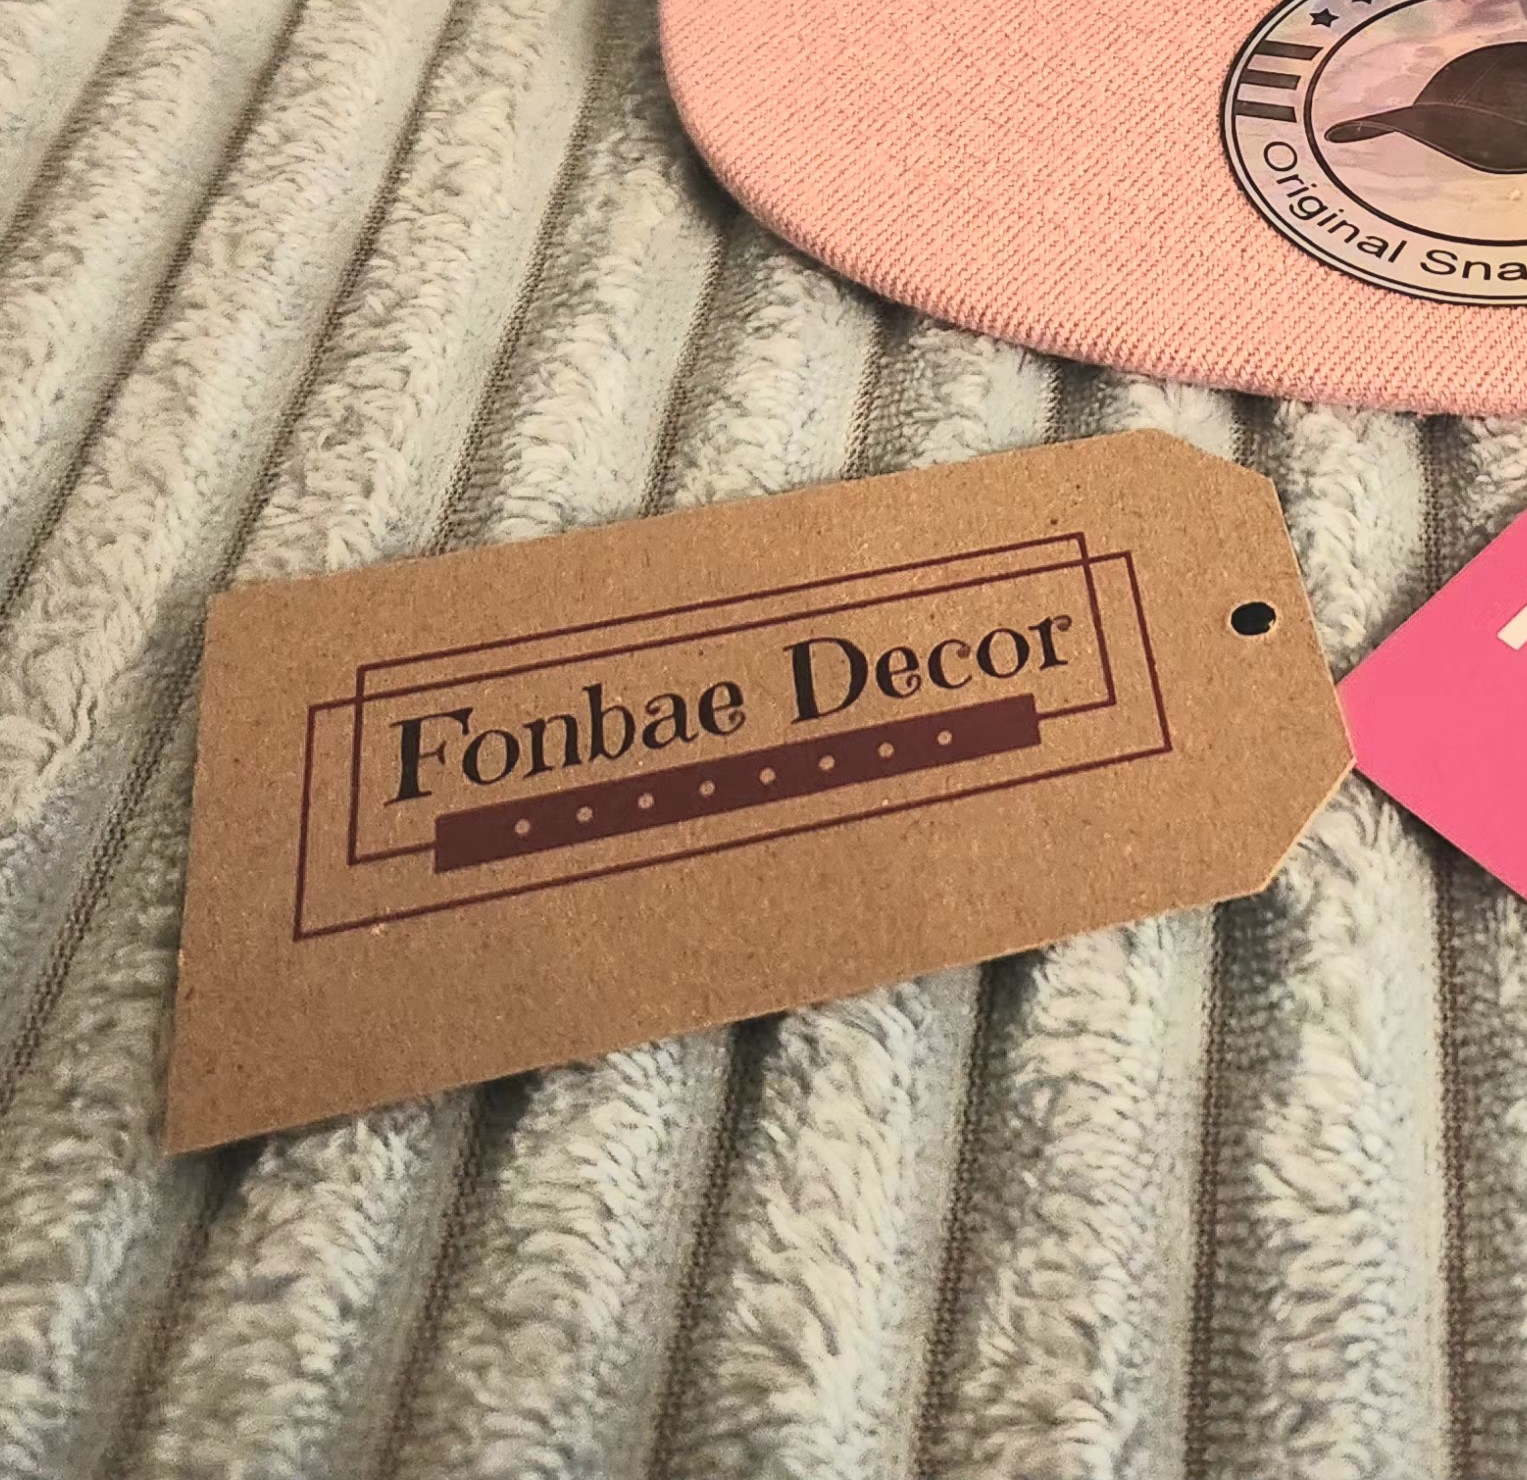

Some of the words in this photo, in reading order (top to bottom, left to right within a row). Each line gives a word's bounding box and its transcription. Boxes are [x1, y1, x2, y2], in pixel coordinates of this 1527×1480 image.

[1263, 141, 1407, 264] Original
[387, 679, 746, 805] Fonbae
[783, 613, 1073, 725] Decor
